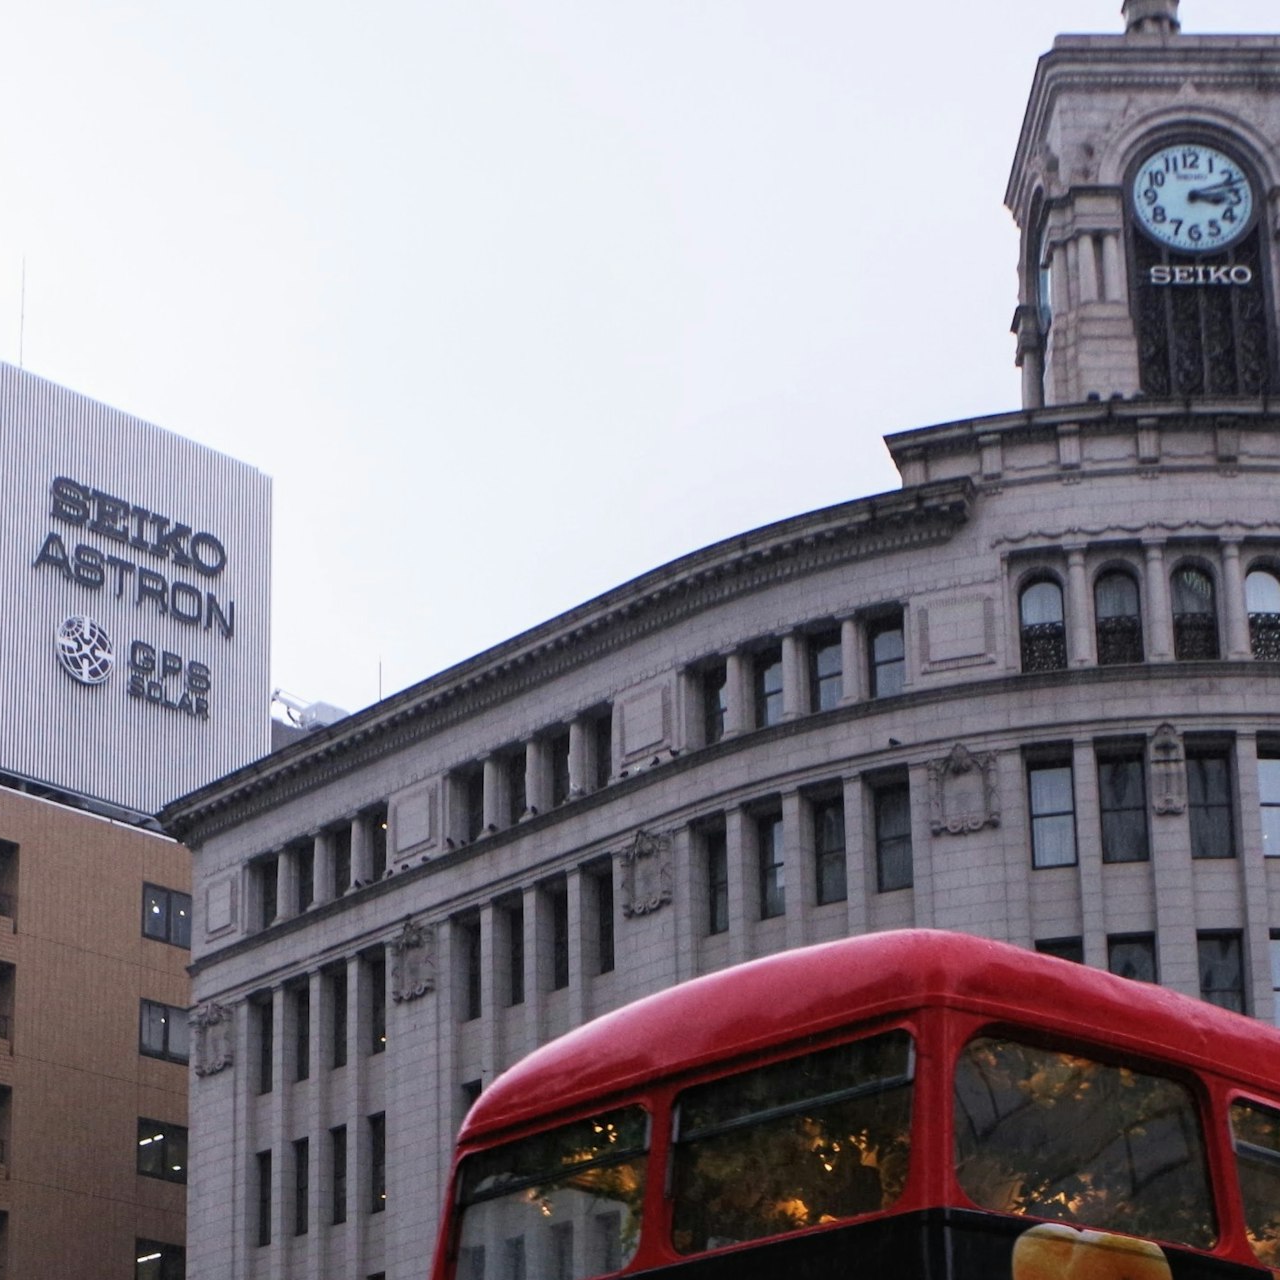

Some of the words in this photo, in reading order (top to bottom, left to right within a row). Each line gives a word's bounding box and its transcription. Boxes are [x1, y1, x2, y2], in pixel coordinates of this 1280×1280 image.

[1165, 157, 1177, 173] 11
[1182, 152, 1199, 168] 12
[1149, 171, 1165, 187] 10
[1144, 189, 1157, 205] 9
[1153, 206, 1166, 223] 8
[1222, 208, 1236, 224] 4
[1170, 219, 1183, 236] 7
[1188, 224, 1202, 241] 6
[1208, 220, 1221, 236] 5
[1150, 265, 1252, 284] SEIKO
[52, 476, 227, 577] SEIKO
[32, 531, 234, 641] ASTRON
[129, 640, 210, 694] GPS
[127, 674, 209, 720] SOLAR
